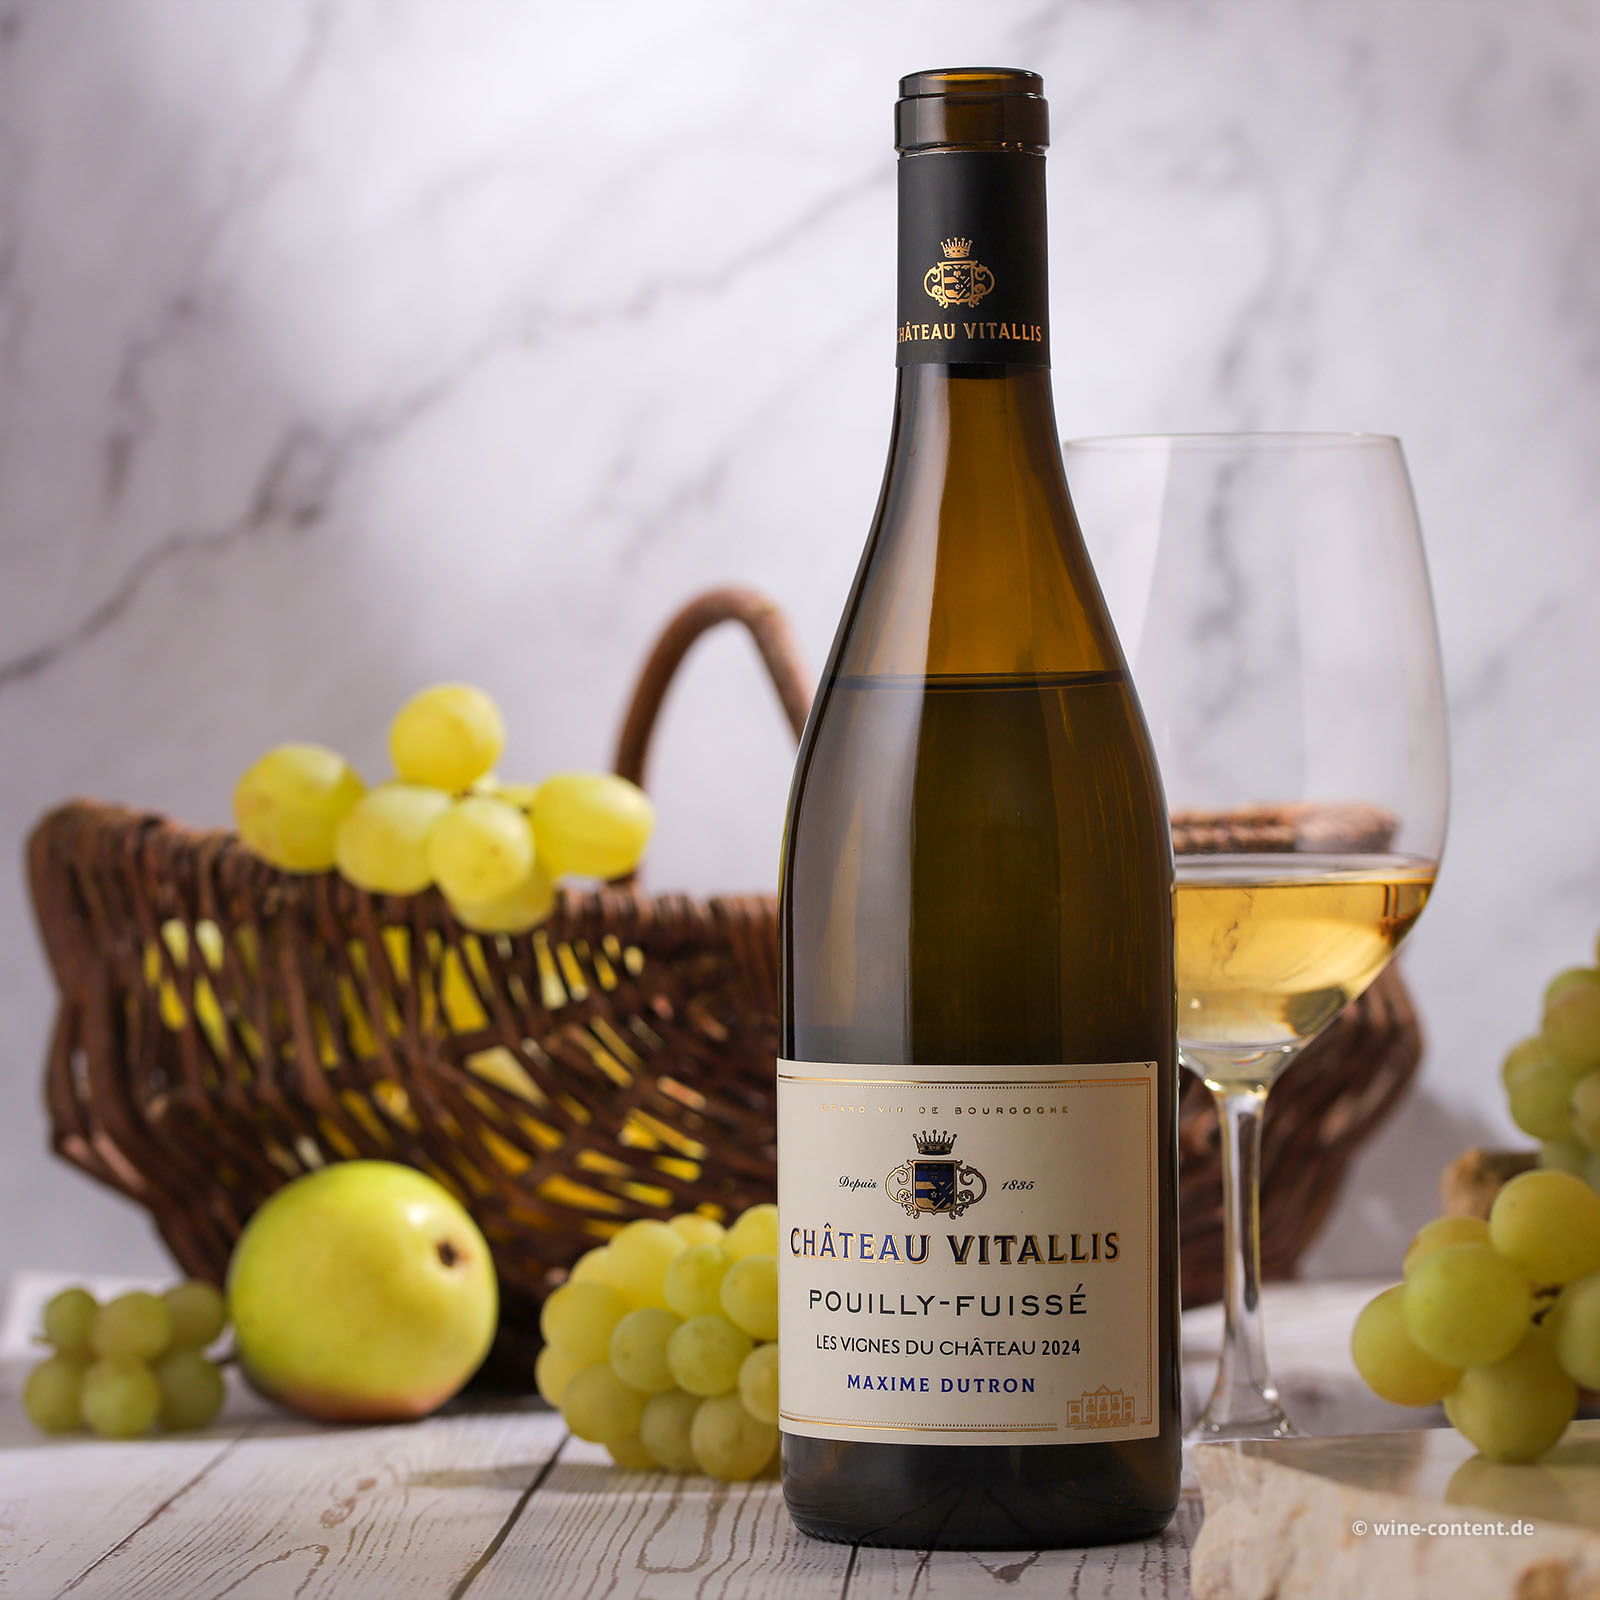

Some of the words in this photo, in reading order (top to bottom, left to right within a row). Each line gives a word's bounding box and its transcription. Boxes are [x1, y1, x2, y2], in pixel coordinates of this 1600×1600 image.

[897, 321, 956, 343] HÂTEAU
[963, 322, 1042, 342] VITALLIS
[821, 1103, 866, 1114] GRAND
[878, 1105, 905, 1114] VIN
[918, 1106, 939, 1115] DE
[954, 1105, 1069, 1115] BOURGOGNE
[838, 1175, 878, 1192] Depuis
[1001, 1179, 1035, 1191] 1835
[790, 1222, 932, 1264] CHÂTEAU
[946, 1231, 1121, 1265] VITALLIS
[809, 1283, 1088, 1317] POUILLY-FUISSÉ
[816, 1334, 837, 1351] LES
[840, 1336, 901, 1355] VIGNES
[905, 1339, 934, 1356] DU
[938, 1337, 1037, 1357] CHÂTEAU
[1041, 1338, 1081, 1356] 2024
[847, 1374, 930, 1393] MAXIME
[940, 1377, 1036, 1394] DUTRON
